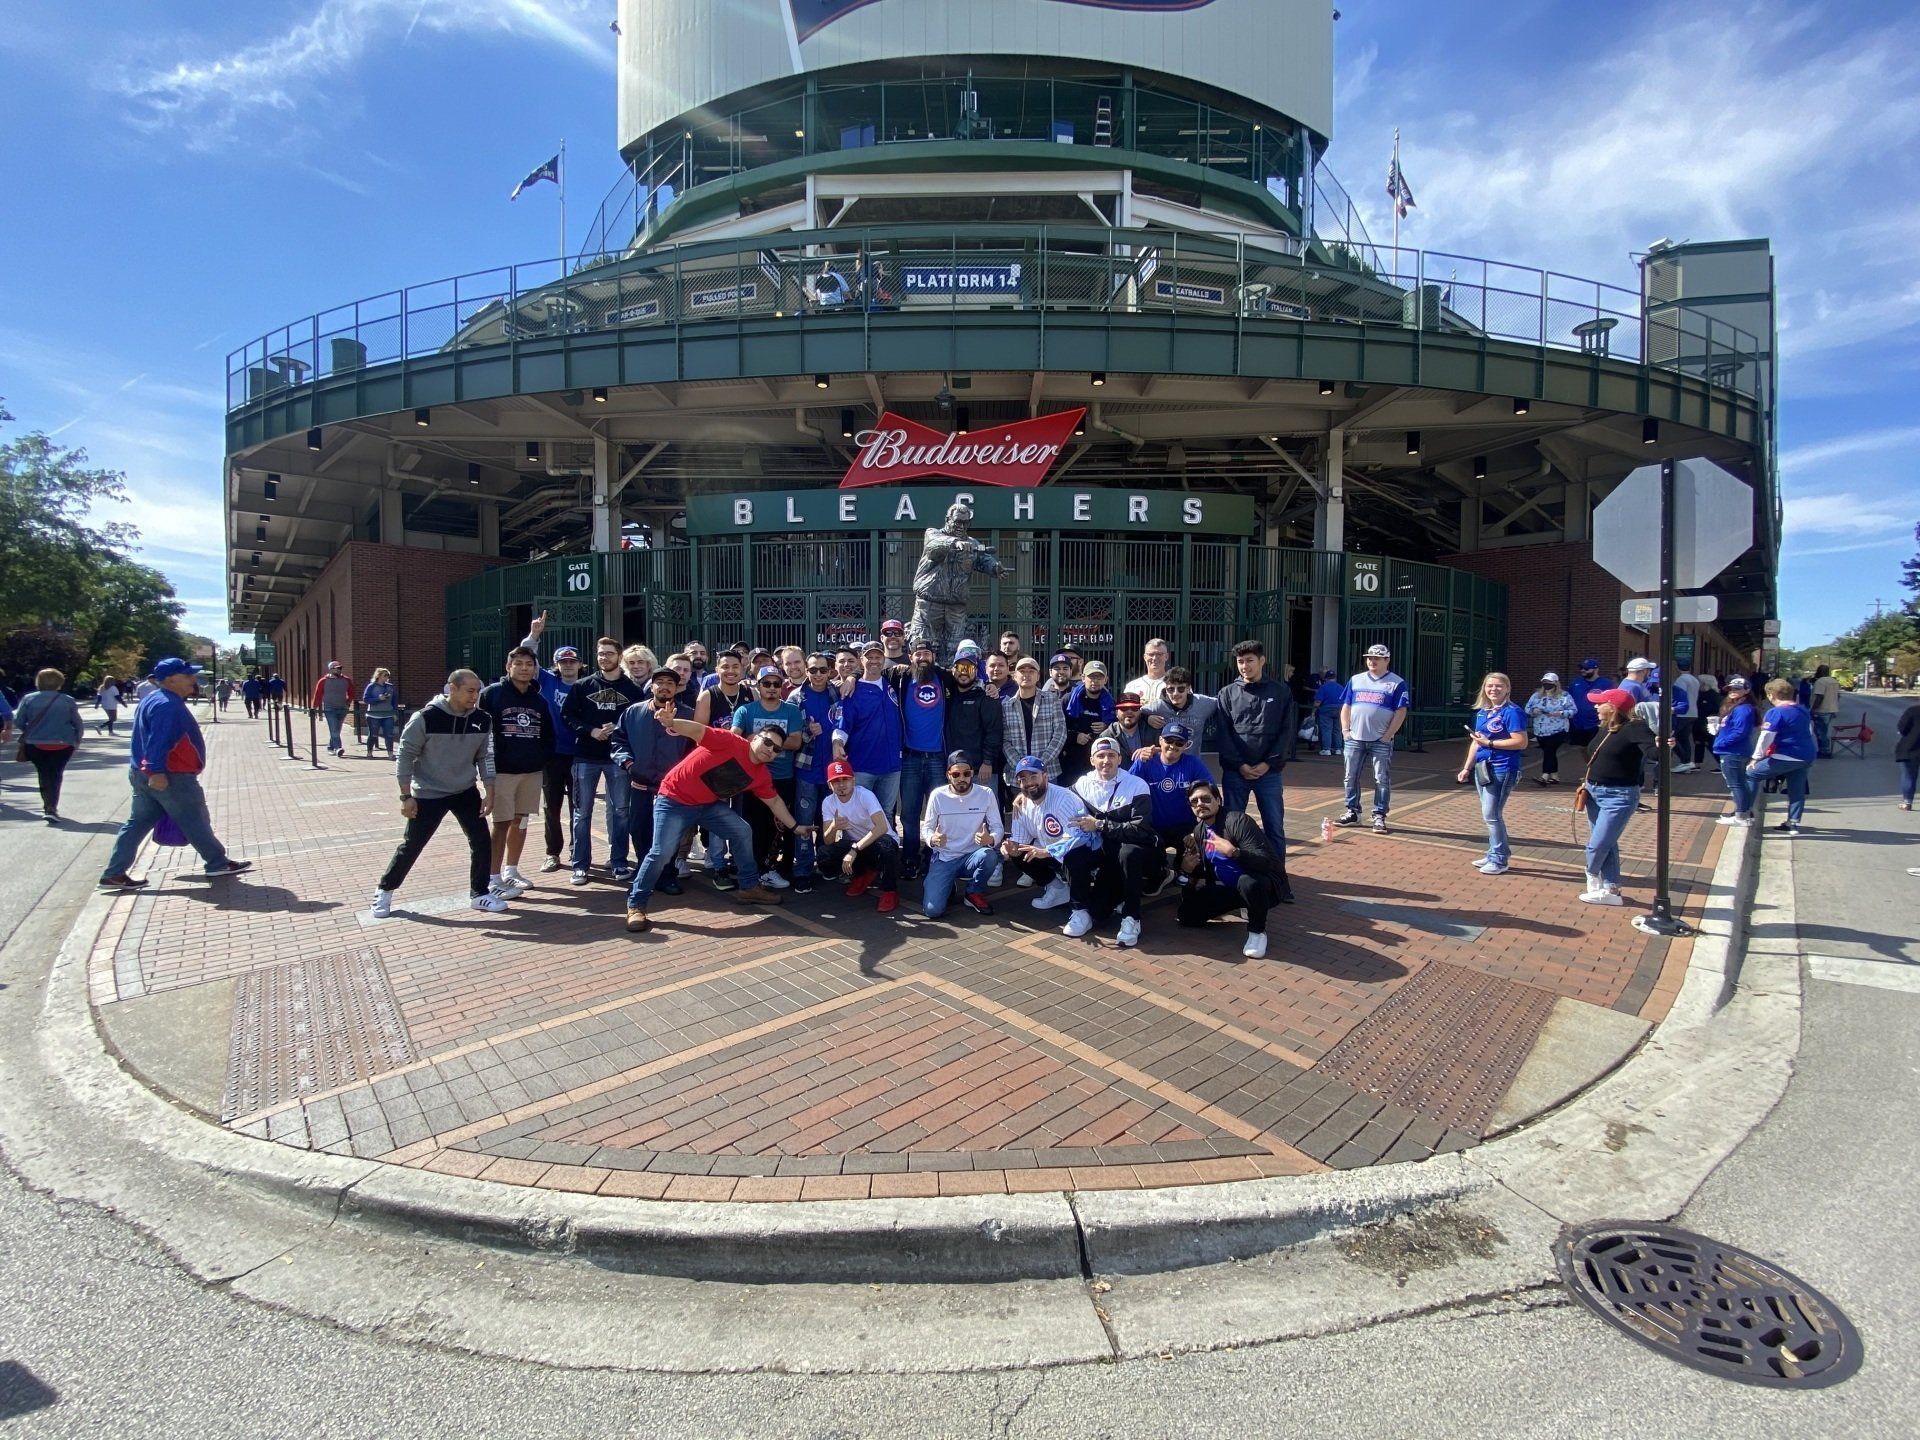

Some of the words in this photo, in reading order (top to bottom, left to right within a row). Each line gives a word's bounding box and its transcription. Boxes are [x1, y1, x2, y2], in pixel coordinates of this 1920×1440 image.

[906, 274, 994, 288] PLATFORM
[999, 274, 1018, 288] 14
[854, 428, 1060, 469] Budweiser
[734, 492, 1203, 526] BLEACHERS
[568, 562, 590, 571] GATE
[1354, 562, 1378, 571] GATE
[567, 572, 591, 592] 10
[1353, 572, 1379, 592] 10
